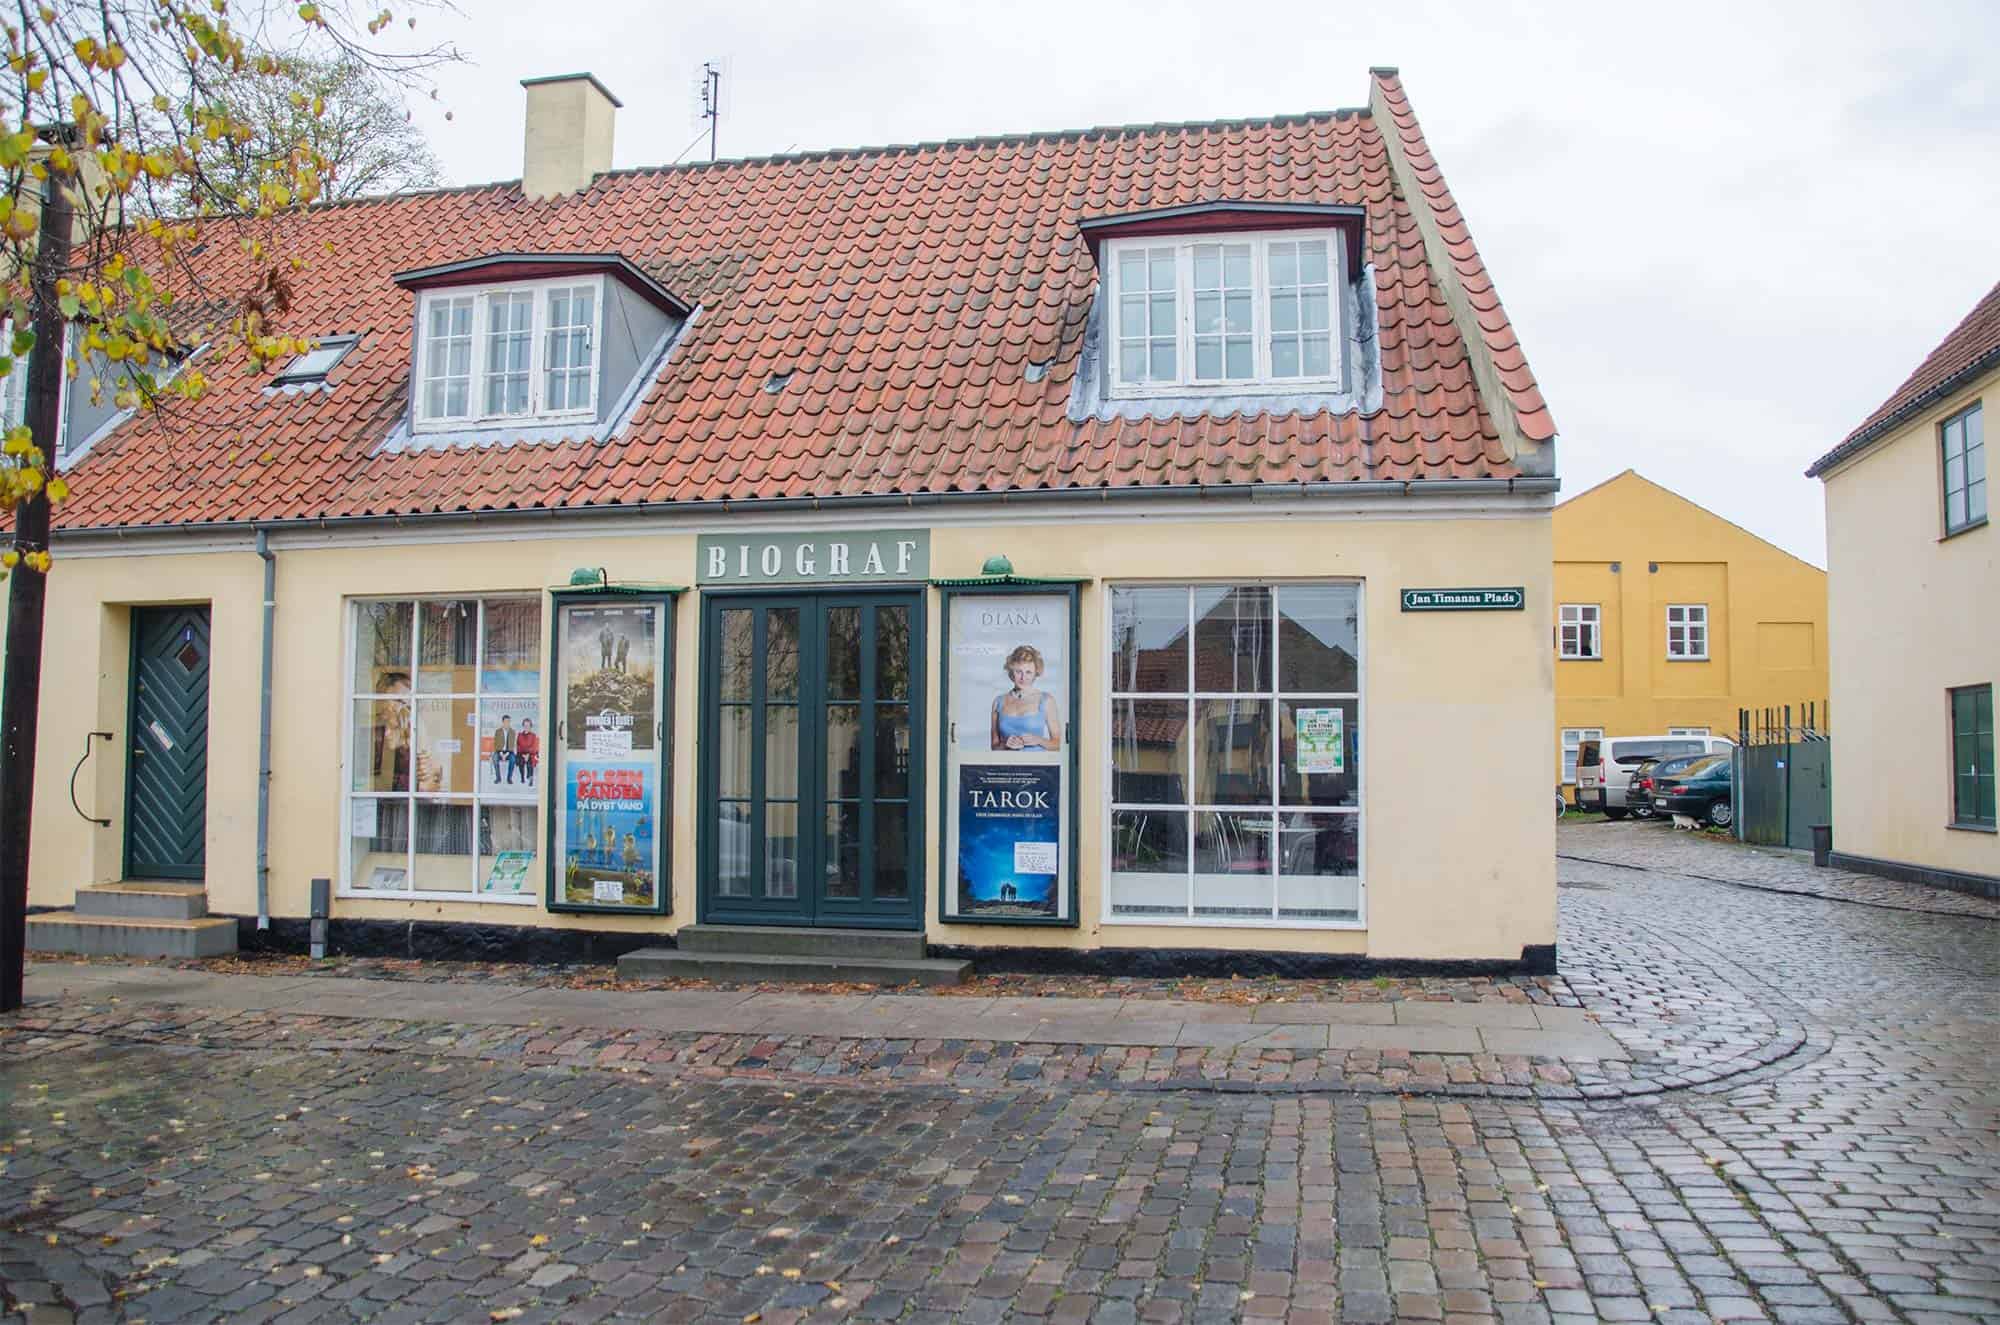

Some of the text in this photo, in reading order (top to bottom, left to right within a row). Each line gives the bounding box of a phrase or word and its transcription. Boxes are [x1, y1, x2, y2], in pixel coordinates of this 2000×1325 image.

[707, 540, 917, 578] BIOGRAF
[1412, 593, 1515, 605] Jan Timanns Plads
[981, 612, 1041, 625] DIANA
[576, 769, 643, 785] OLSEN
[577, 799, 643, 811] PÅ DYBT VAND
[969, 790, 1050, 808] TAROK
